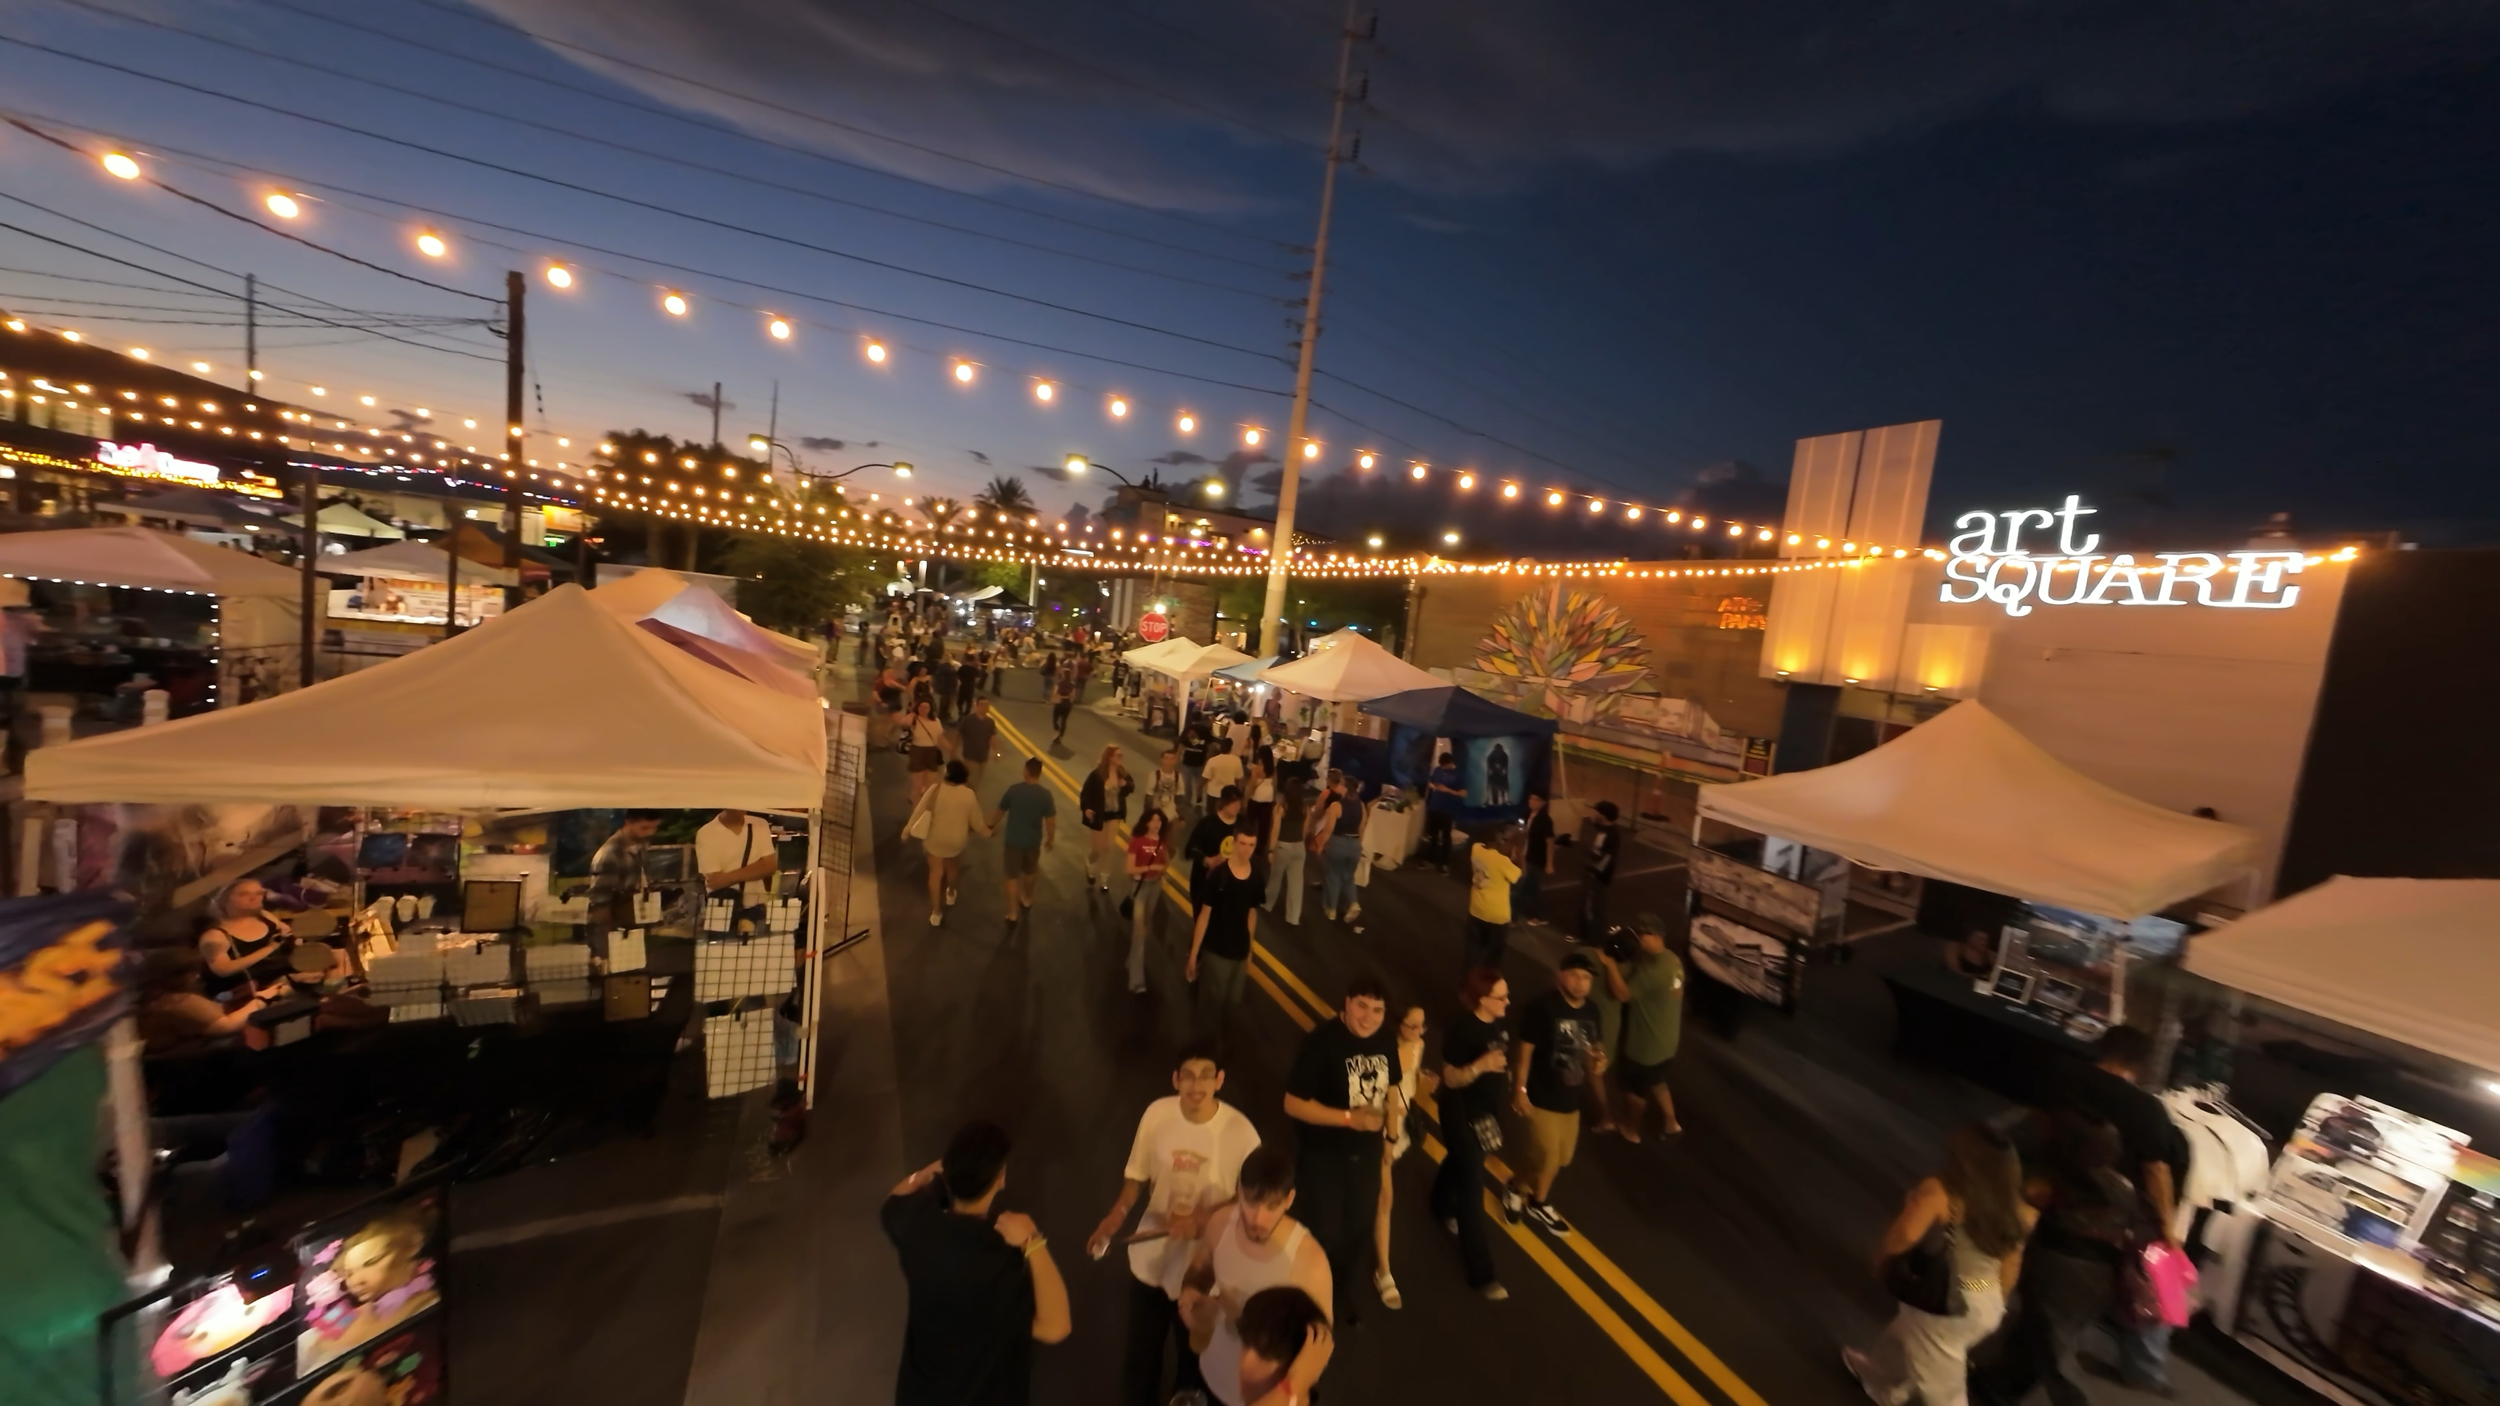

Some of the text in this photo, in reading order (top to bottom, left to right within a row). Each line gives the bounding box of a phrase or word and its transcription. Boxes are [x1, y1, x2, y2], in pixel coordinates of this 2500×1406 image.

[1948, 494, 2100, 557] art
[1940, 551, 2304, 617] SQUARE
[1141, 620, 1167, 634] STOP
